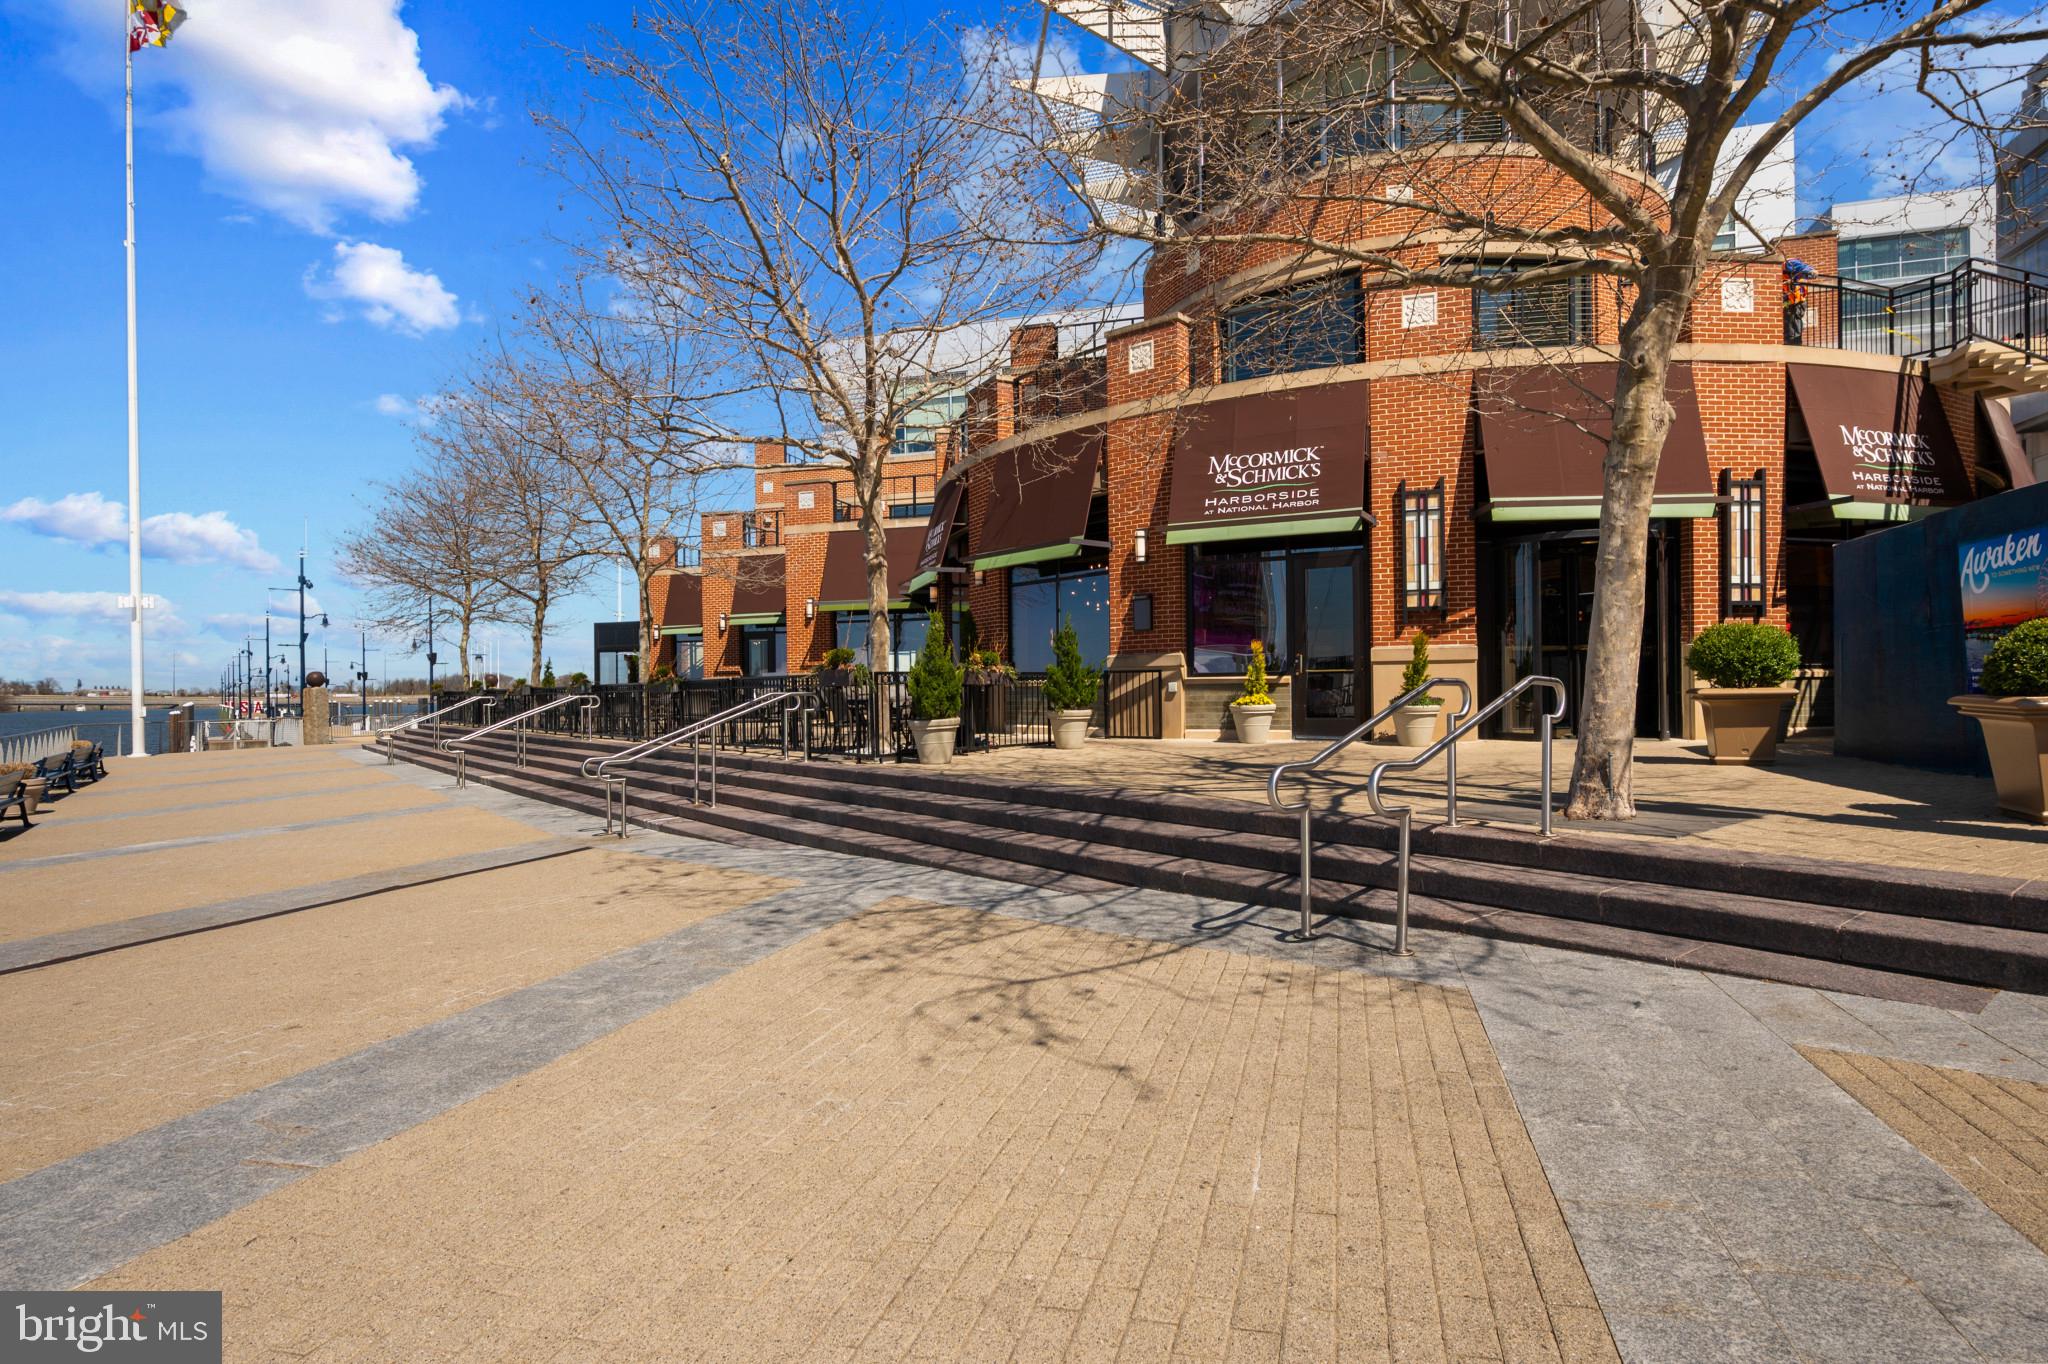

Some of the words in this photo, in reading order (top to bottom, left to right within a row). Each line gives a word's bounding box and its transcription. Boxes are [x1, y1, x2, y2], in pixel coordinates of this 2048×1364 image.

[1852, 471, 1942, 486] HARBORSIDE
[1866, 483, 1907, 492] NATIONAL
[1909, 485, 1945, 494] HARBOR
[1205, 488, 1320, 507] HARBORSIDE
[1217, 504, 1269, 514] NATIONAL
[1272, 499, 1320, 509] HARBOR
[1961, 532, 2043, 594] Awaken
